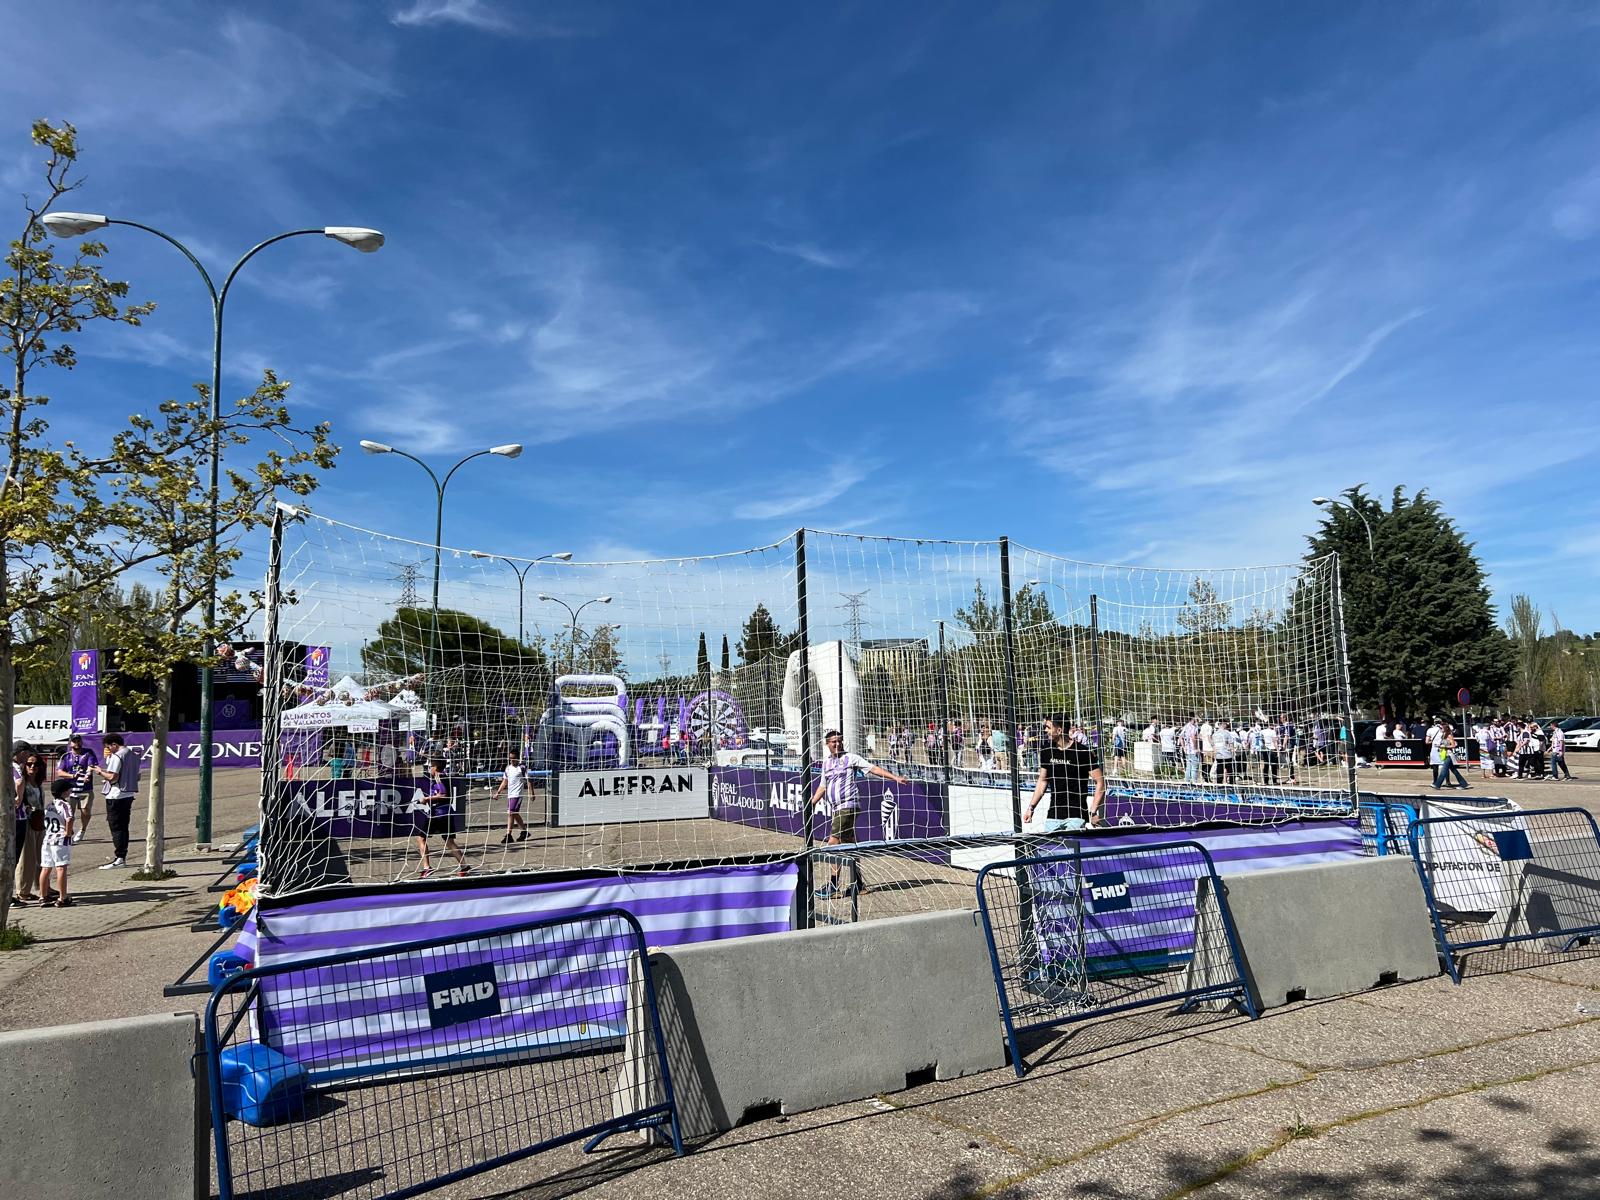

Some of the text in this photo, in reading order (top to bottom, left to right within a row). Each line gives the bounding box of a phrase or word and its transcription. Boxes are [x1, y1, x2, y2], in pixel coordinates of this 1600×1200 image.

[72, 680, 97, 688] ZONE
[283, 712, 332, 721] ALIMENTOS
[26, 720, 73, 730] ALEFR
[187, 741, 261, 759] ZONE
[1386, 746, 1412, 755] Estrella
[578, 774, 693, 798] ALEFRAN
[720, 782, 738, 796] REAL
[720, 794, 765, 811] VALLADOLID
[769, 782, 832, 817] ALEFA
[1486, 861, 1501, 873] DE
[1091, 884, 1128, 901] FMD
[432, 981, 495, 1010] FMD
